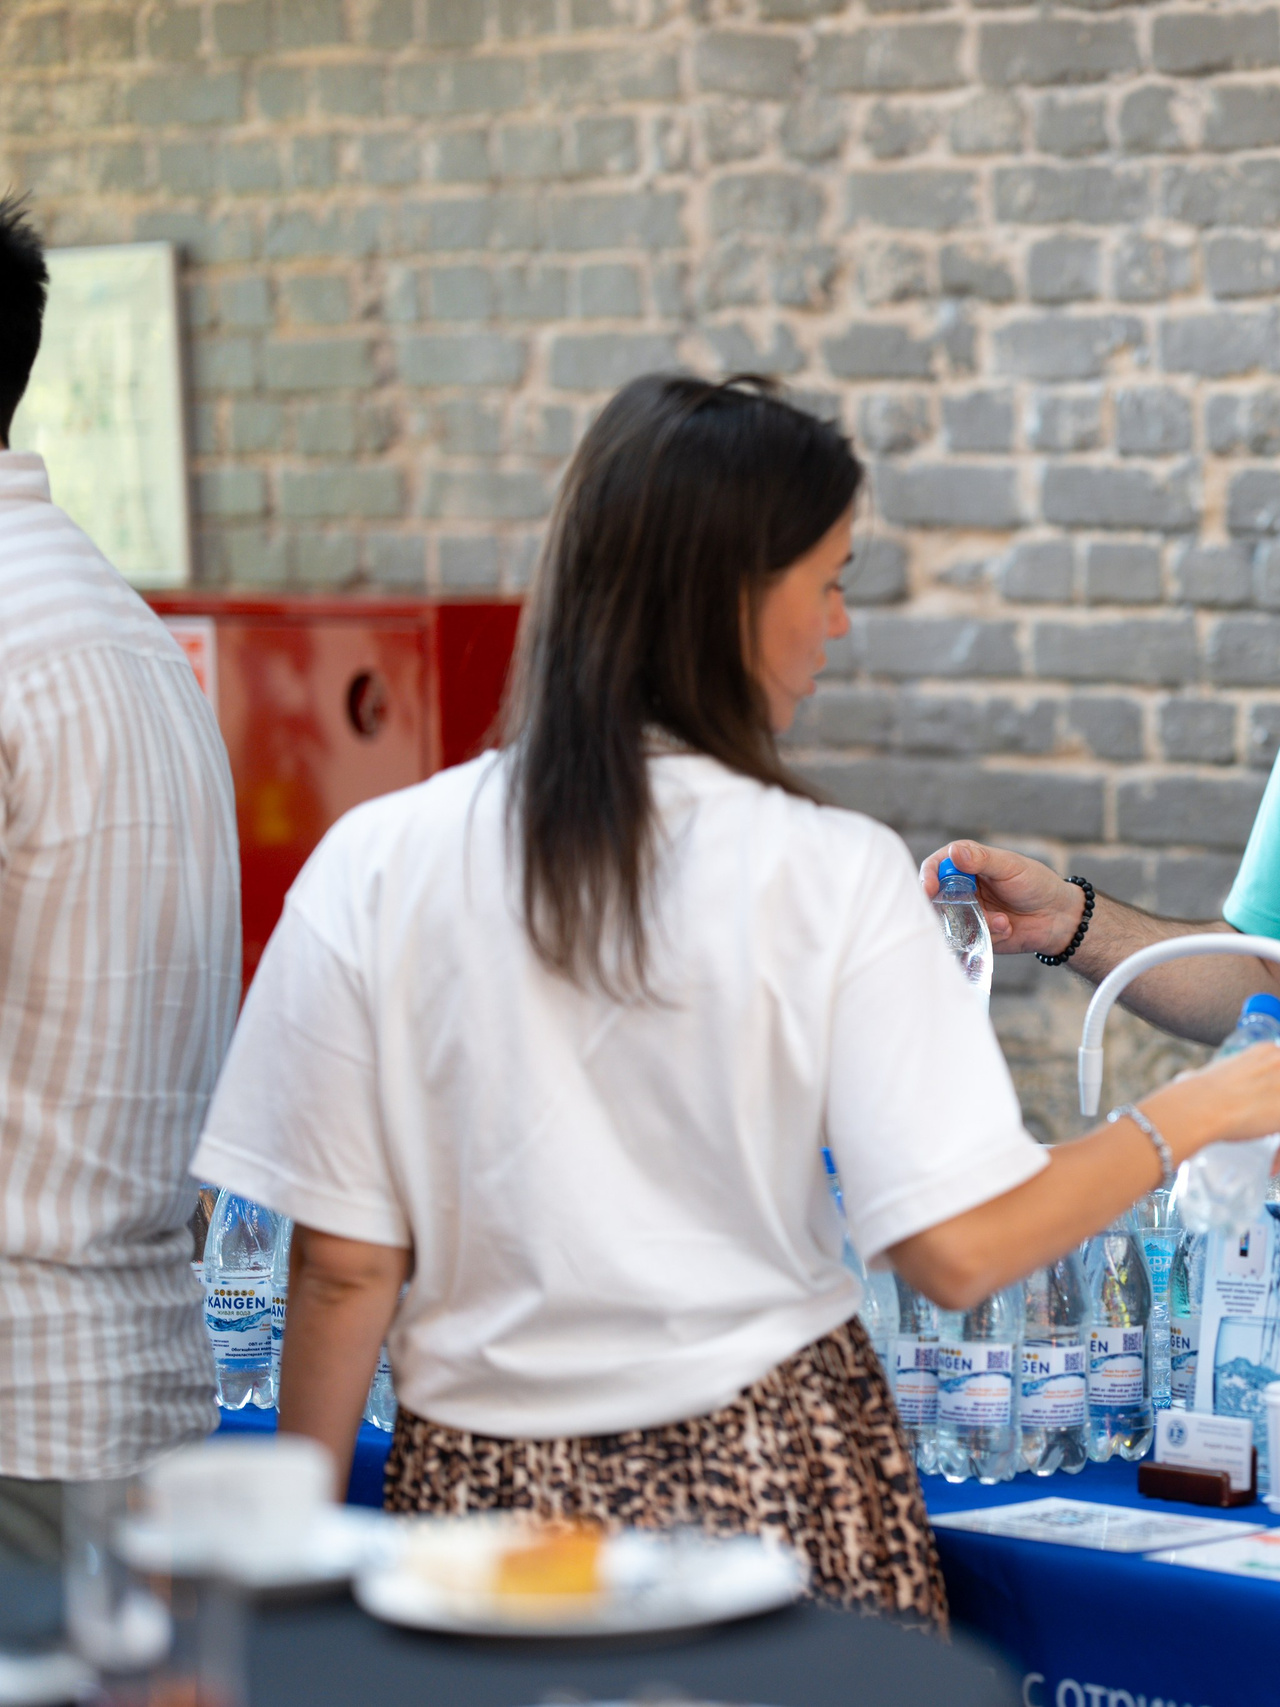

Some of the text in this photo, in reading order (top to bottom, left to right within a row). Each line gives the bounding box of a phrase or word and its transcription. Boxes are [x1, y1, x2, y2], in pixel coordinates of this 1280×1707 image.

[207, 1295, 266, 1310] KANGEN
[1090, 1340, 1108, 1353] EN
[1170, 1335, 1191, 1350] GEN
